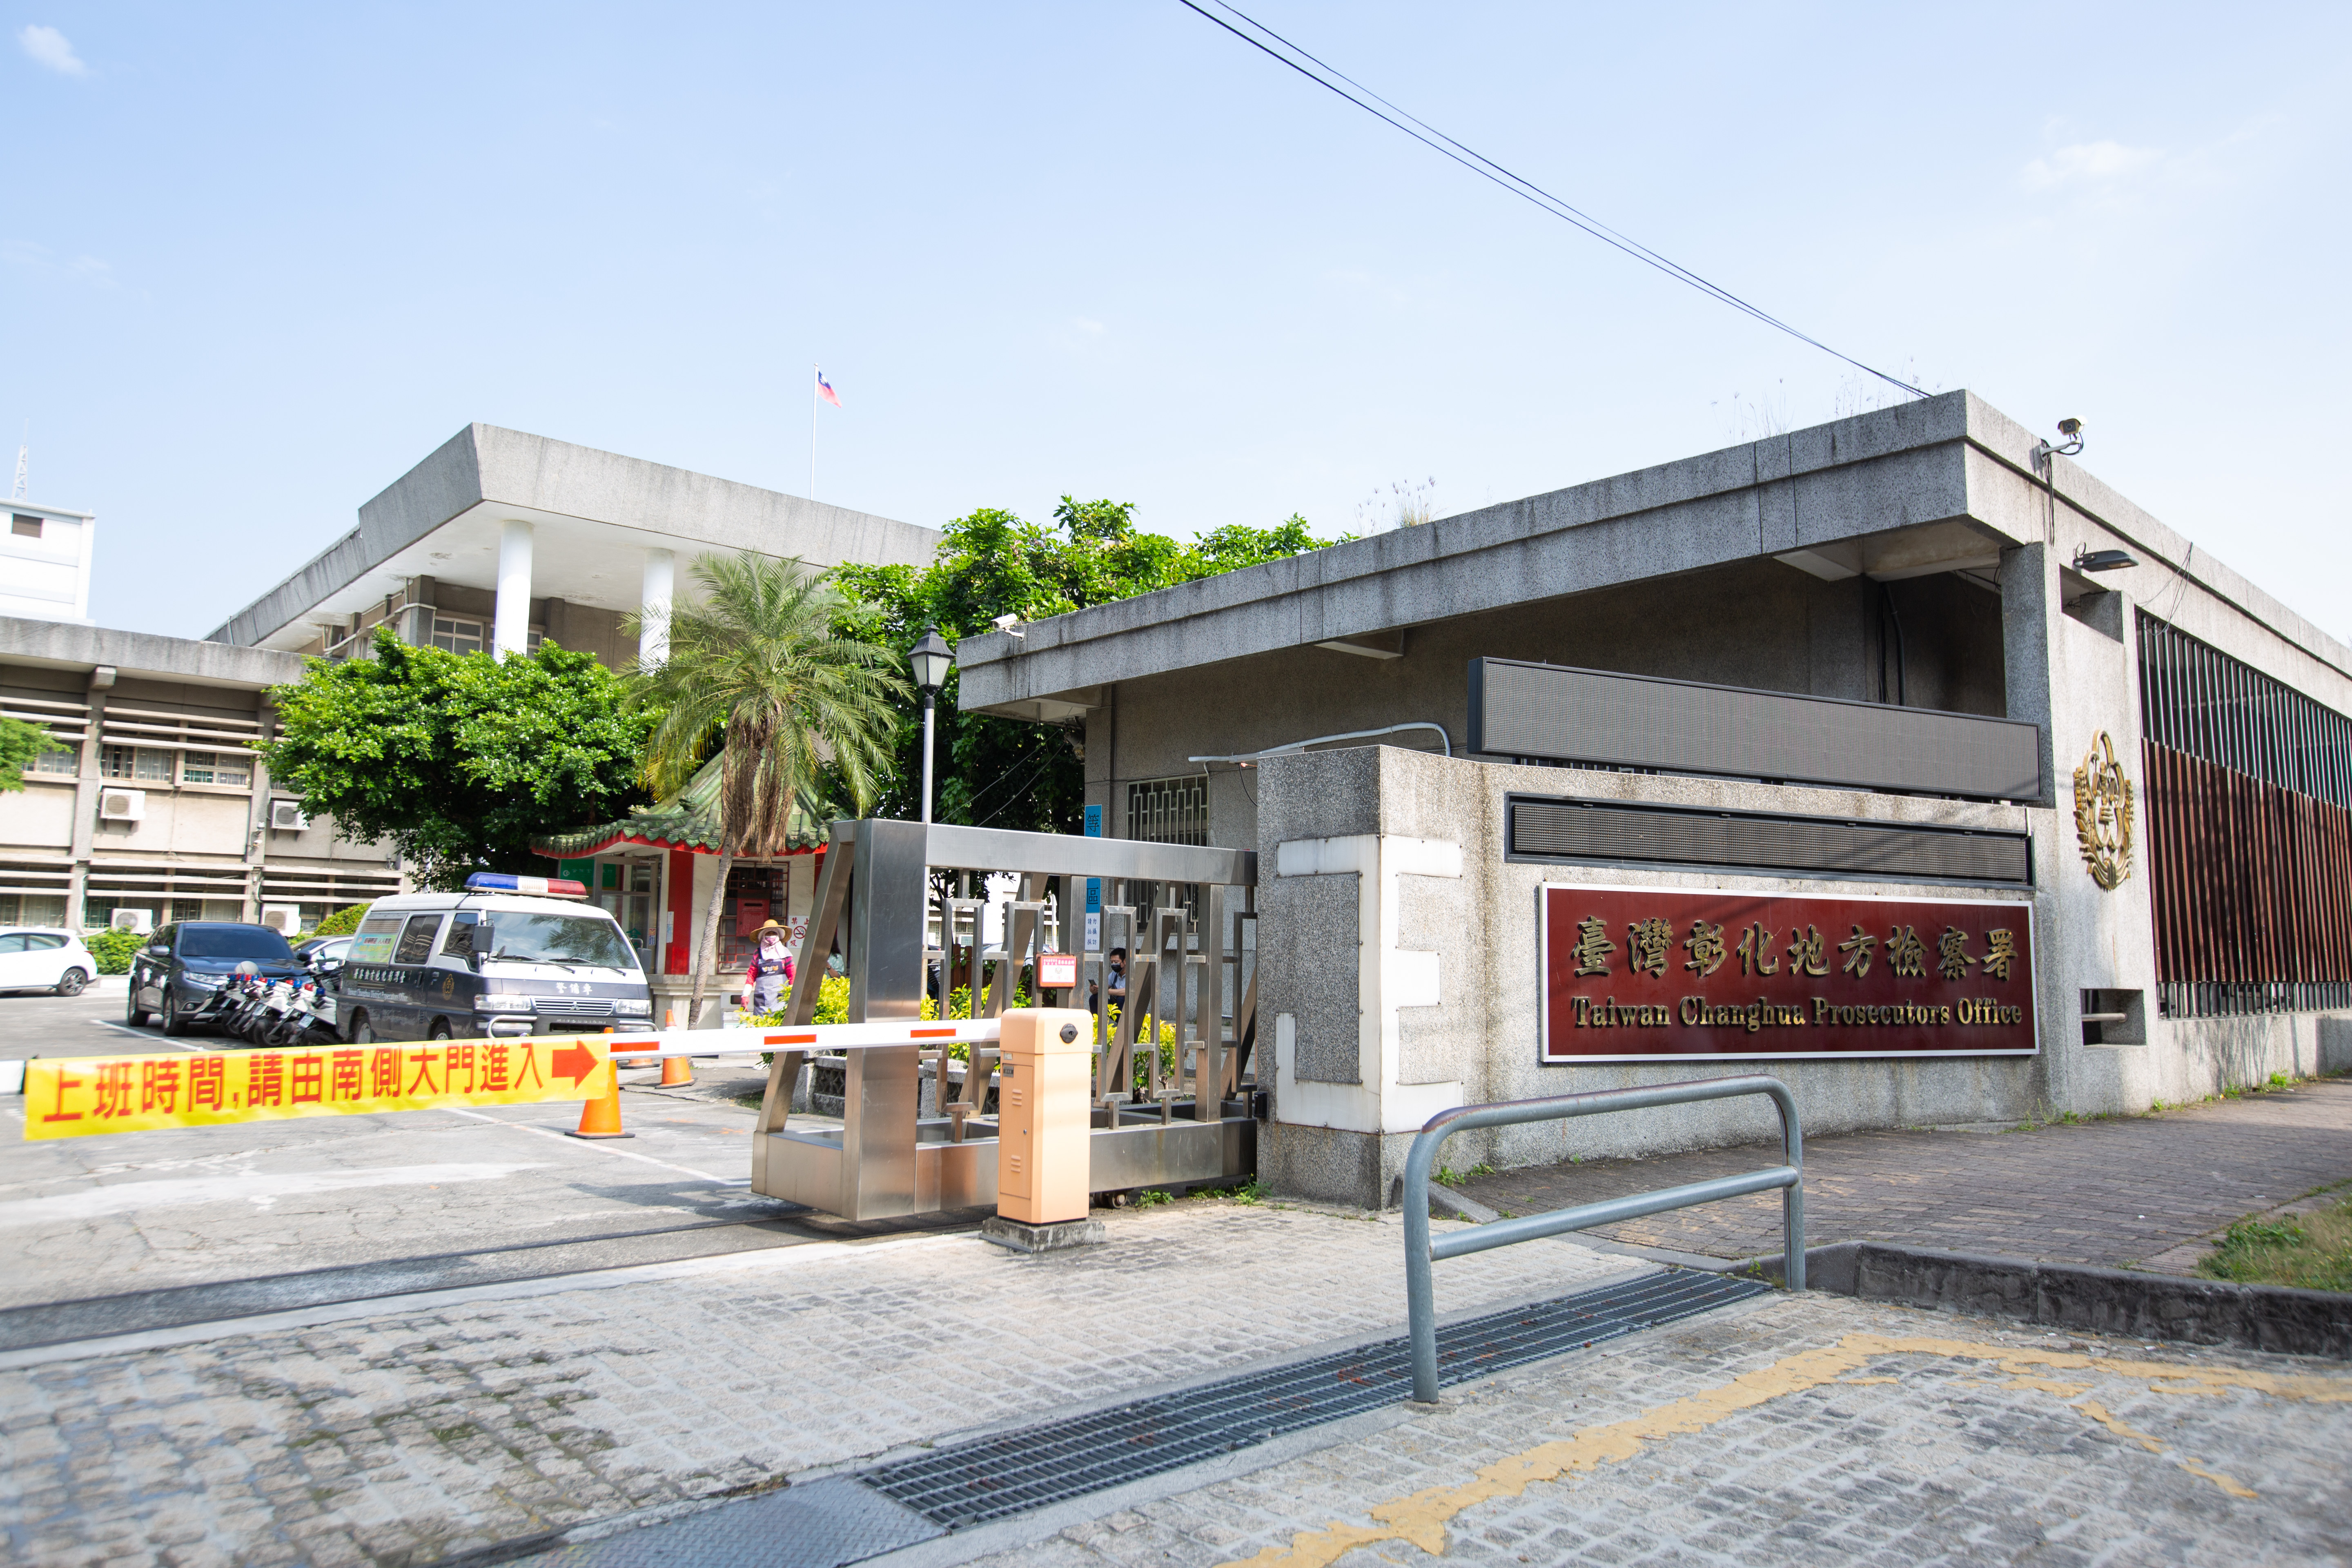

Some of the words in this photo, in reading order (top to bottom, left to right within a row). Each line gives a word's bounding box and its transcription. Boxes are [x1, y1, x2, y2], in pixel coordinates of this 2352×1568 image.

[791, 917, 809, 925] 禁止
[1571, 915, 2018, 981] 臺灣彰化地方檢察署
[556, 982, 592, 996] 警備車
[1572, 996, 1671, 1028] Taiwan
[1679, 996, 1806, 1033] Changhua
[1811, 996, 1950, 1027] Prosecutors
[1957, 997, 2023, 1025] Office
